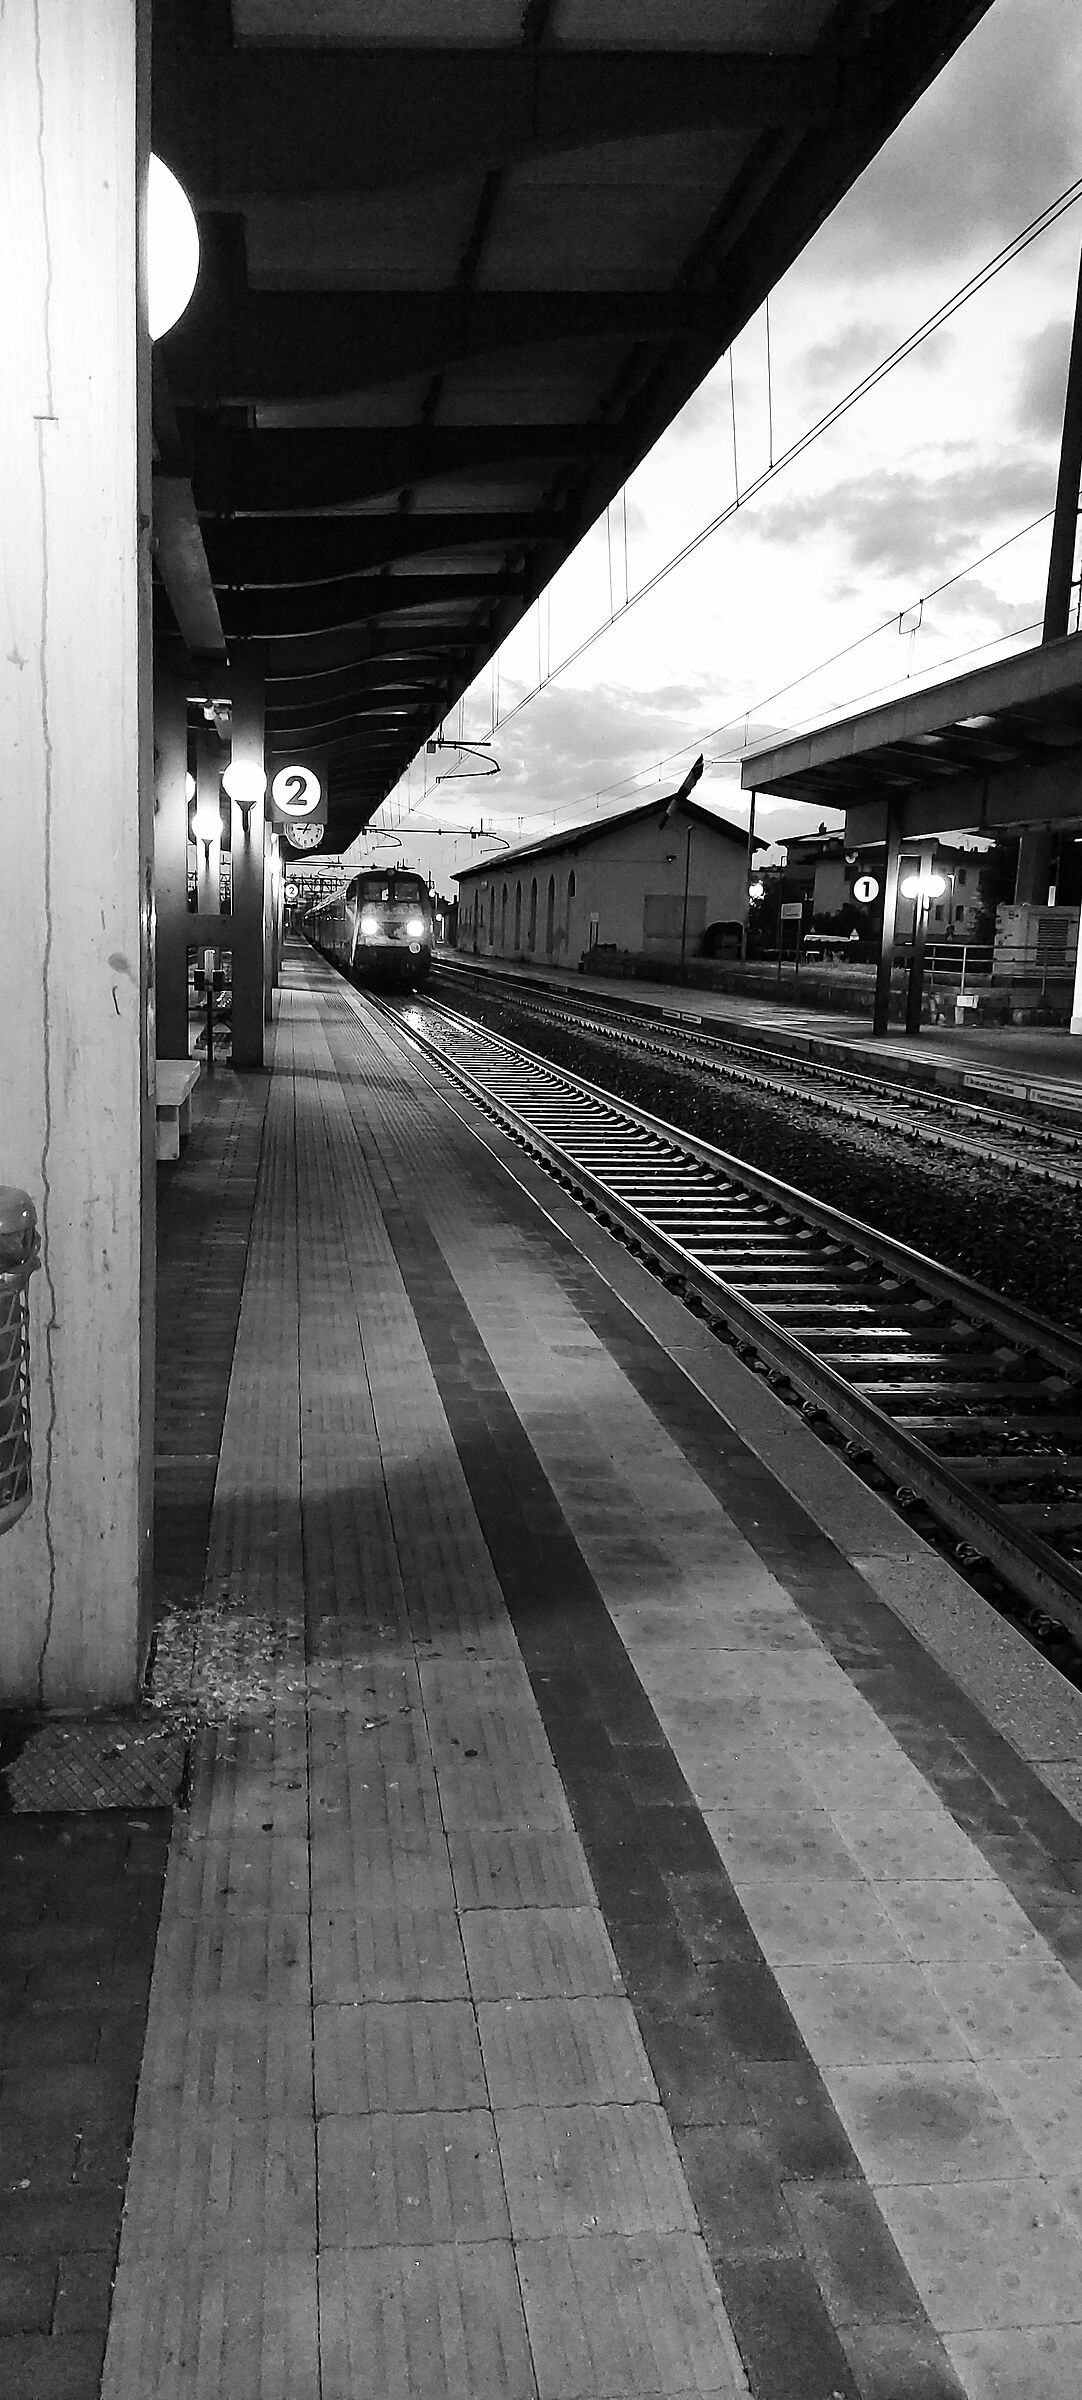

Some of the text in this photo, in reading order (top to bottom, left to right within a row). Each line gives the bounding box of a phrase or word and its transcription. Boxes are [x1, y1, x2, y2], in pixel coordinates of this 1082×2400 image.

[285, 775, 307, 805] 2
[289, 886, 295, 895] 2
[863, 881, 870, 897] 1
